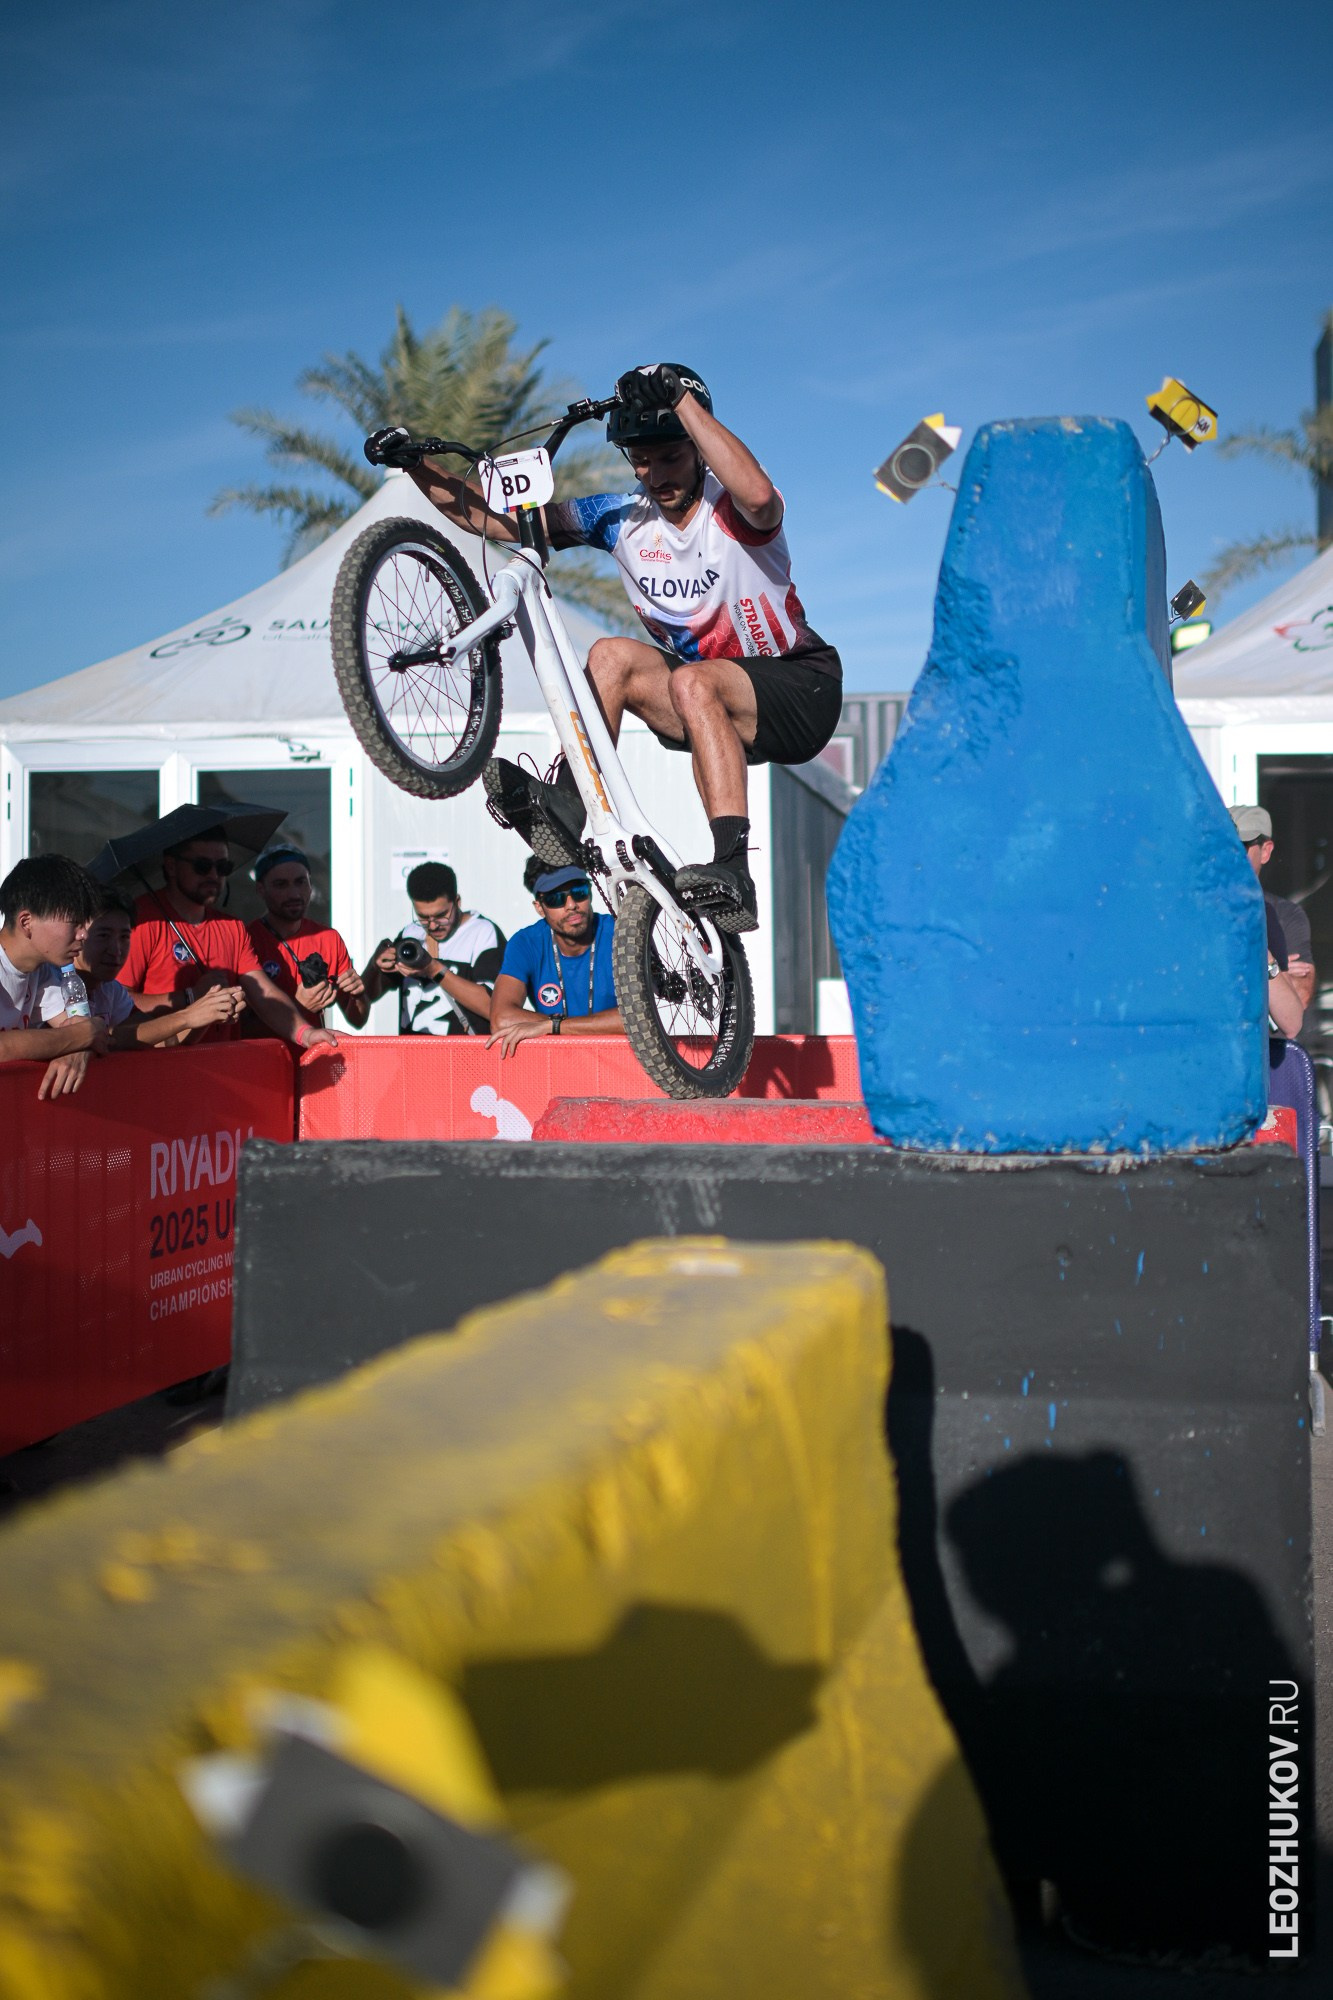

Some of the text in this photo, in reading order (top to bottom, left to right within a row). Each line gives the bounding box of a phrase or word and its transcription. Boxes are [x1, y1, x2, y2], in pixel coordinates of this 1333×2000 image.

[502, 474, 531, 497] 8D
[740, 598, 773, 657] STRABAG
[150, 1198, 237, 1260] 2025 U
[150, 1265, 183, 1290] URBAN
[185, 1253, 224, 1279] CYCLING
